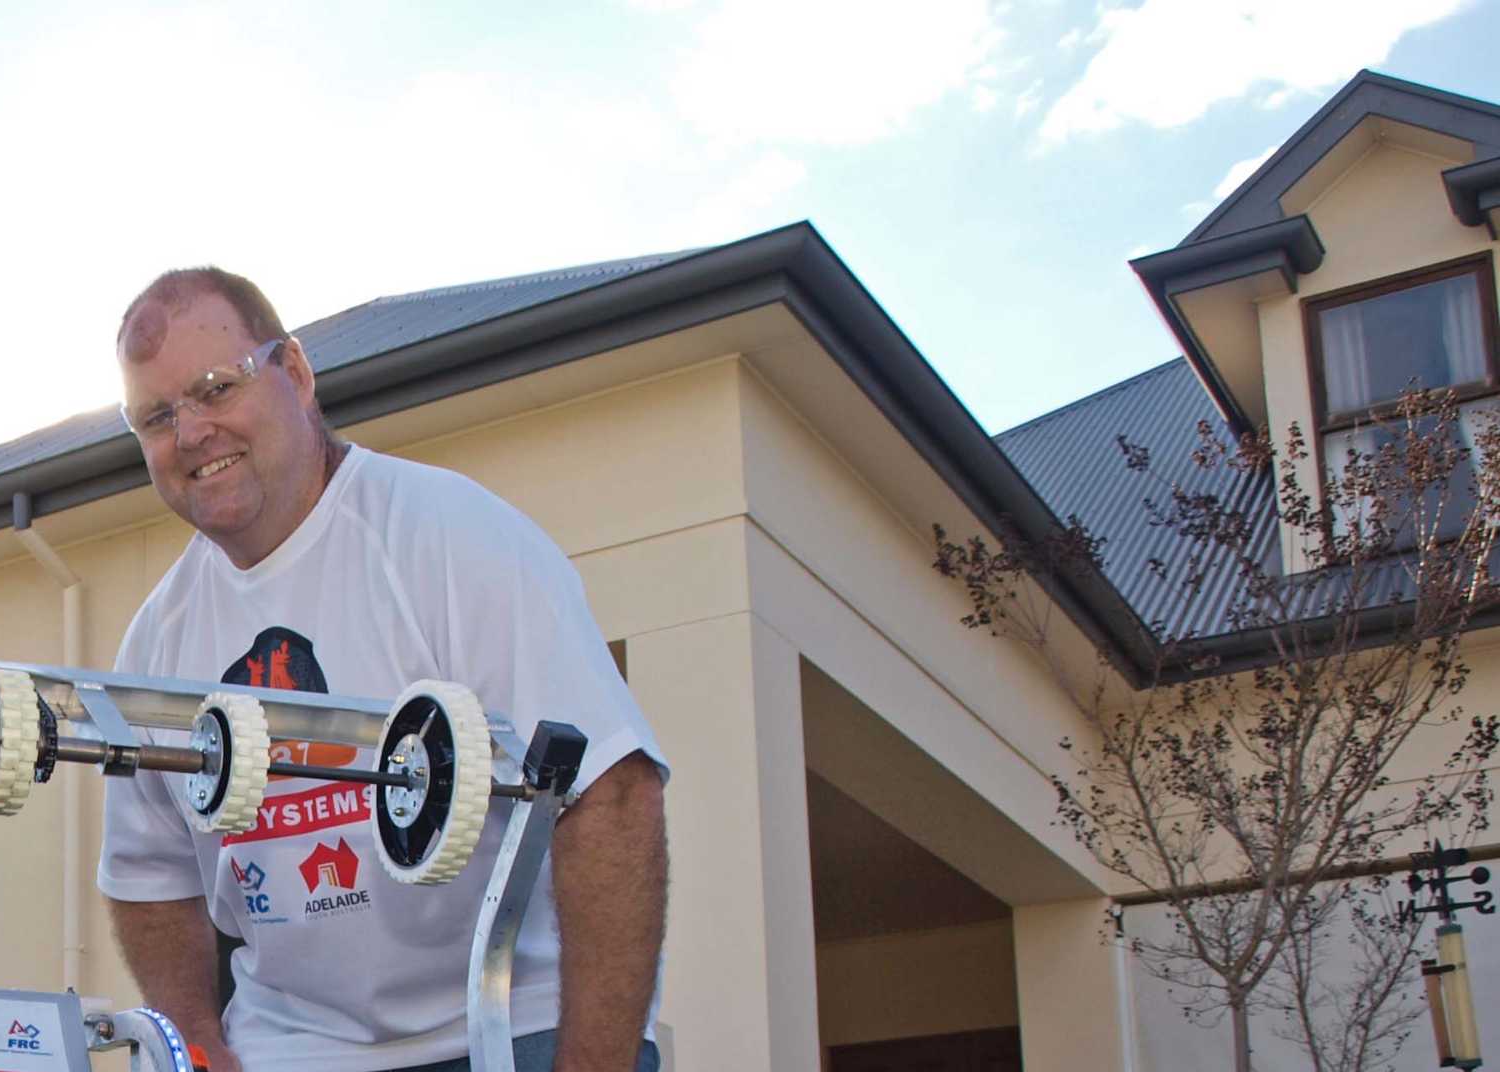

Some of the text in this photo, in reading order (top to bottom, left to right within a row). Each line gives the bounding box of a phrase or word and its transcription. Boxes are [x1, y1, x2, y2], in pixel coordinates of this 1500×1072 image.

[250, 786, 372, 831] YSTEMS
[304, 890, 370, 915] ADELAIDE
[7, 1038, 41, 1050] FRC
